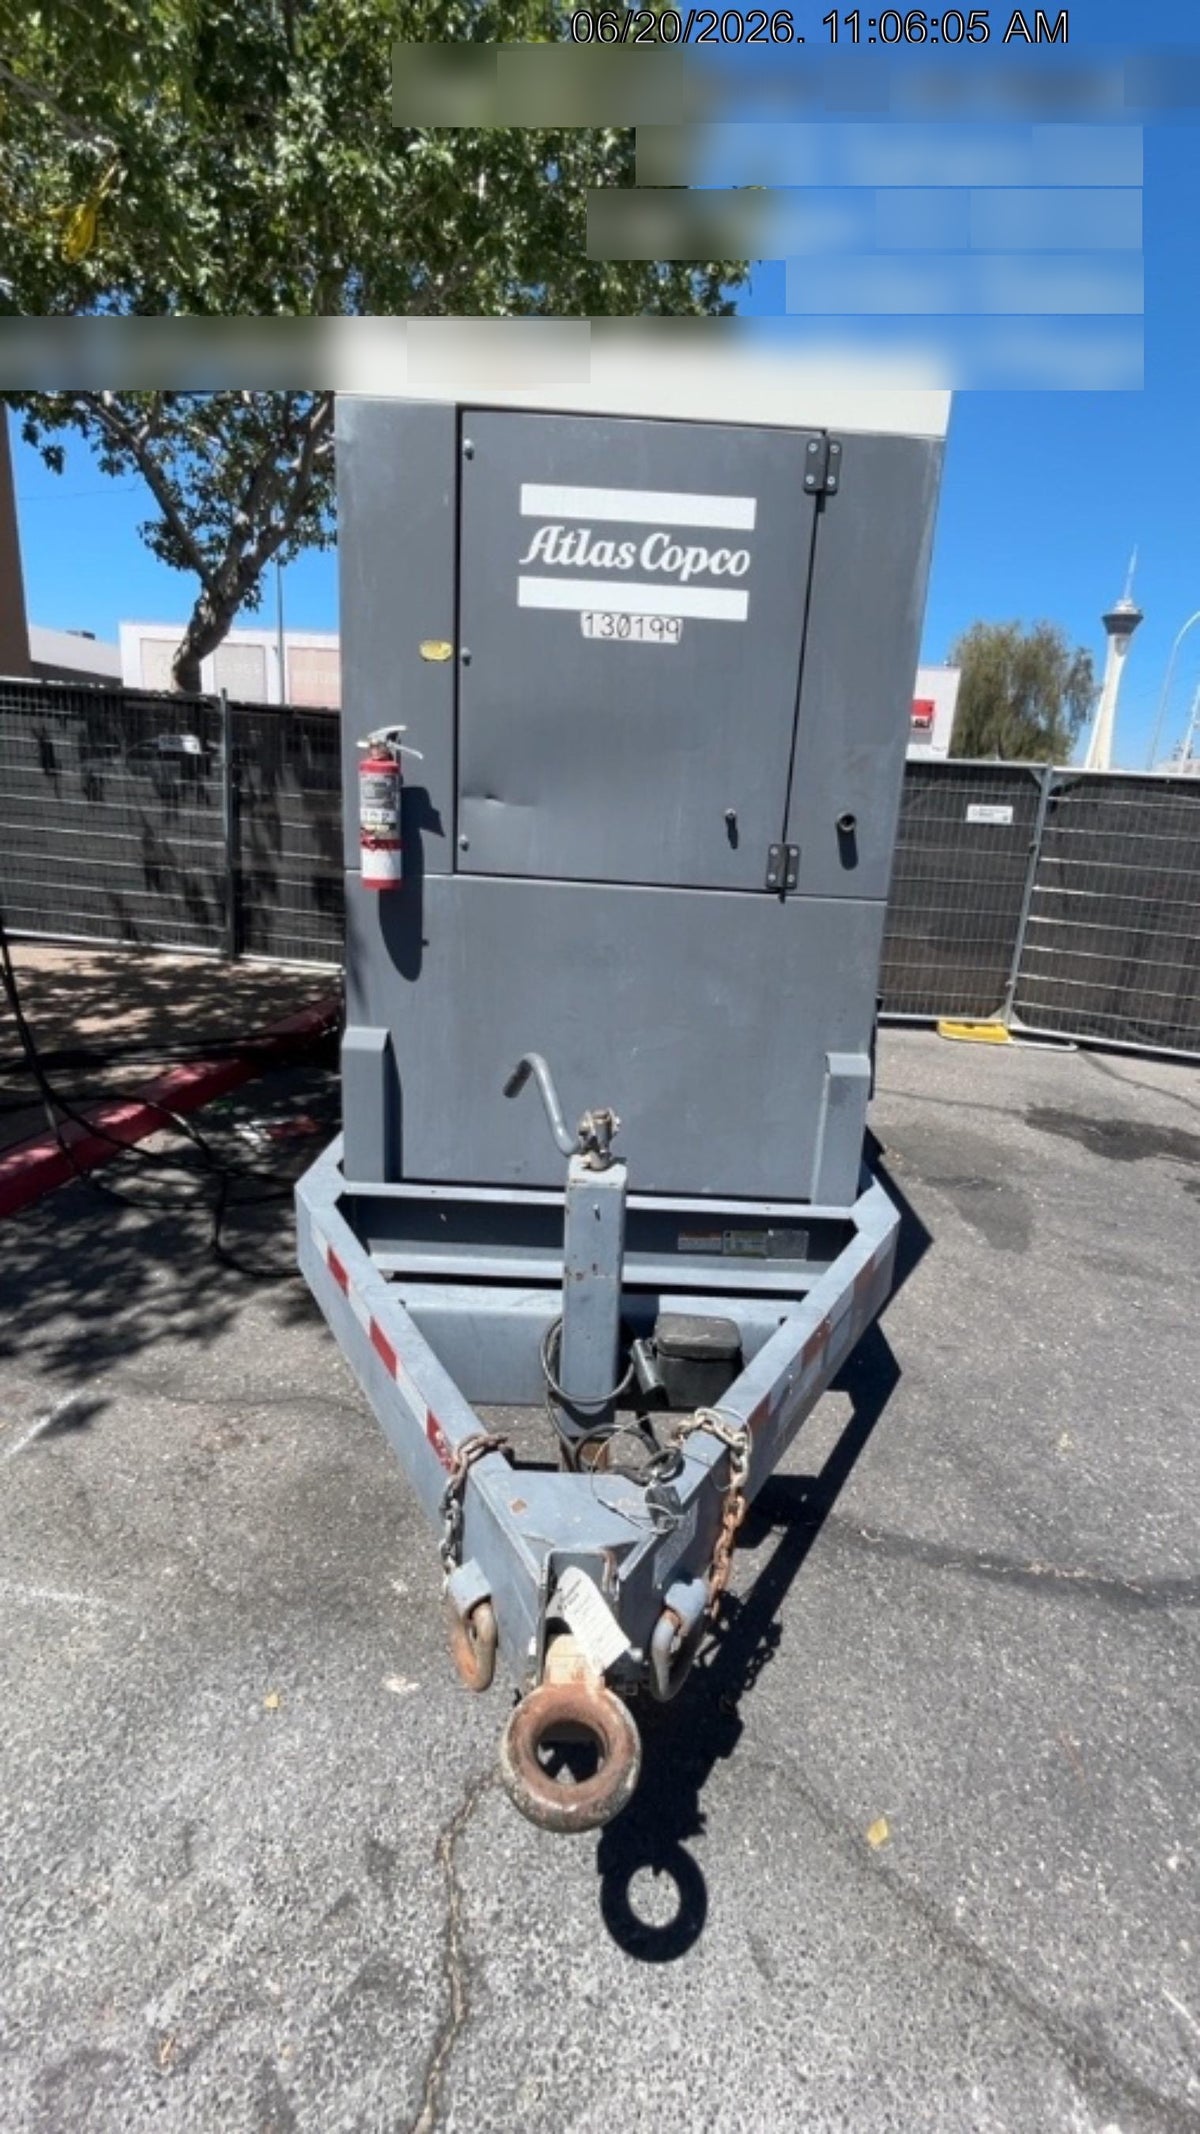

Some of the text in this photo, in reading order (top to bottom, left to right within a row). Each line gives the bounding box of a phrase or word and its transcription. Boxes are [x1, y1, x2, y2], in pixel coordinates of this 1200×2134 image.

[518, 525, 751, 582] Atlas Copco
[585, 612, 680, 642] 130199
